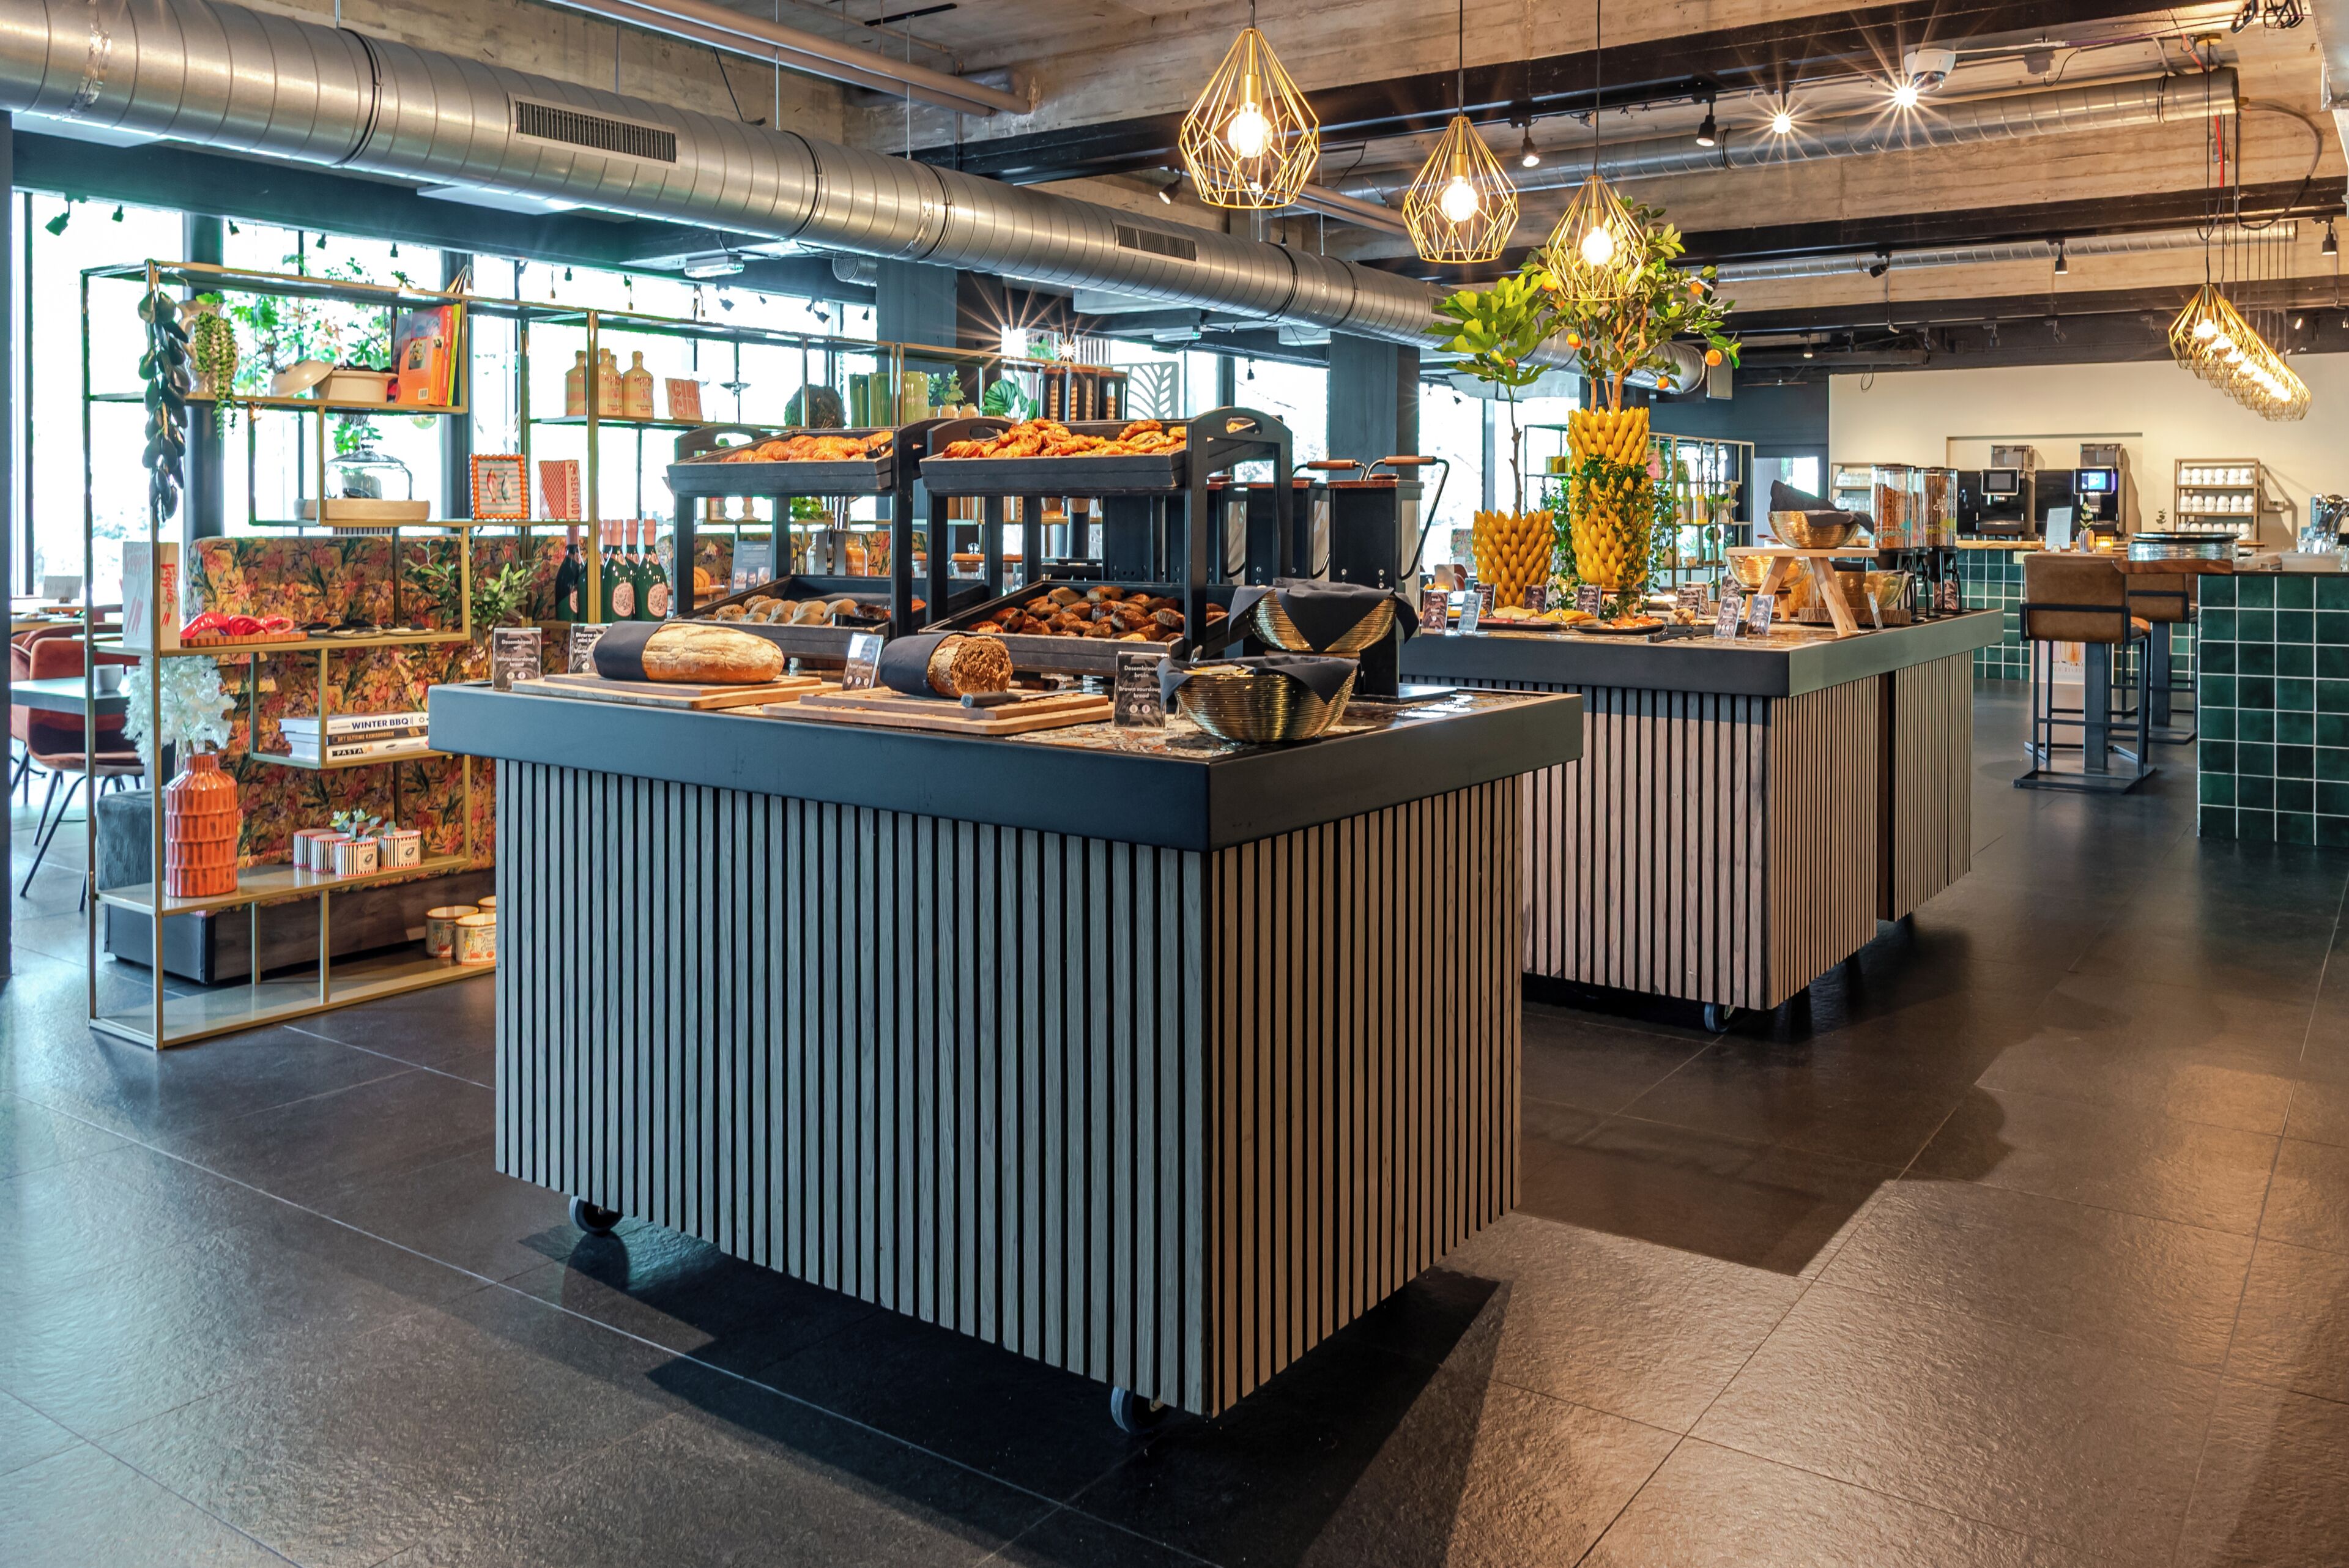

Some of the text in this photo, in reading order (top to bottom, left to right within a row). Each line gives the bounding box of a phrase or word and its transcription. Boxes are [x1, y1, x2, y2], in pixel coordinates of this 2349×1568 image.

[671, 380, 697, 399] CIN
[673, 398, 699, 415] CIN
[571, 477, 580, 515] SEAFOOD
[352, 719, 387, 730] WINTER
[390, 718, 409, 726] BBQ
